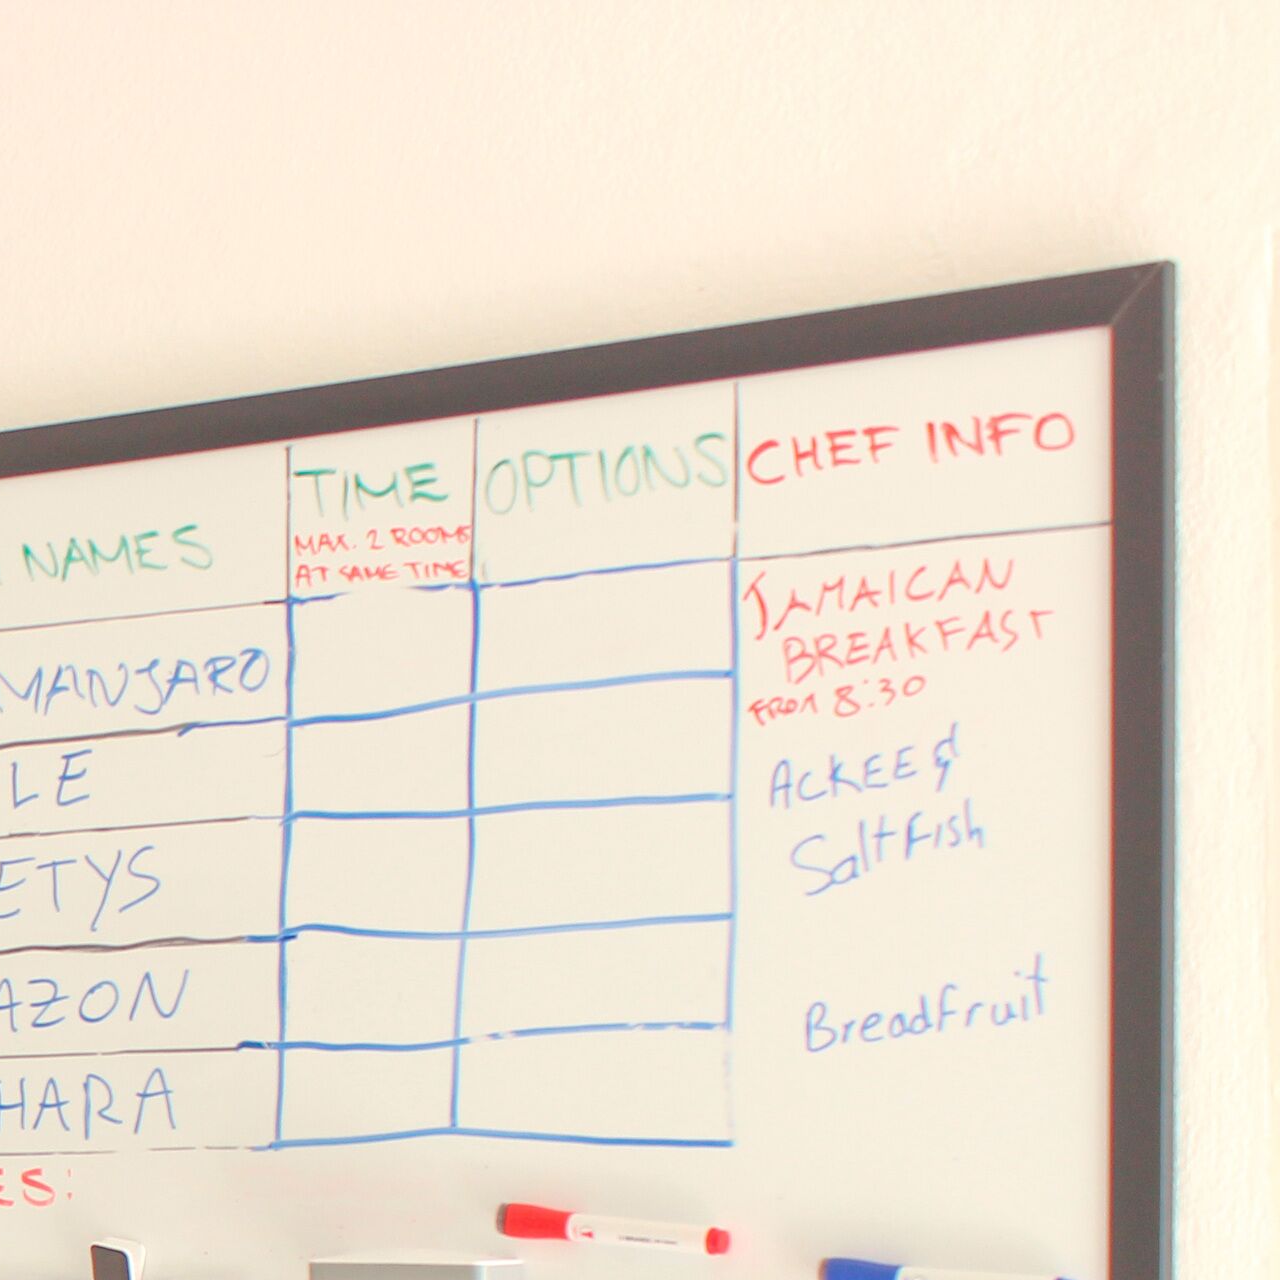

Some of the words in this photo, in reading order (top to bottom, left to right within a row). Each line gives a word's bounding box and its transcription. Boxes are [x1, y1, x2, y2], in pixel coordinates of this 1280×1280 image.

[484, 432, 729, 514] OPTIONS
[746, 425, 900, 486] CHEF
[926, 412, 1076, 463] INFO
[293, 462, 449, 520] TIME
[23, 524, 214, 582] NAMES
[366, 529, 384, 550] 2
[391, 525, 472, 548] ROOMS
[295, 564, 336, 588] AT
[338, 564, 400, 581] SAME
[403, 560, 469, 580] TIME
[743, 558, 1014, 640] JAMAICAN
[783, 610, 1055, 684] BREAKFAST
[749, 695, 818, 728] FROM
[770, 746, 917, 809] ACKEE
